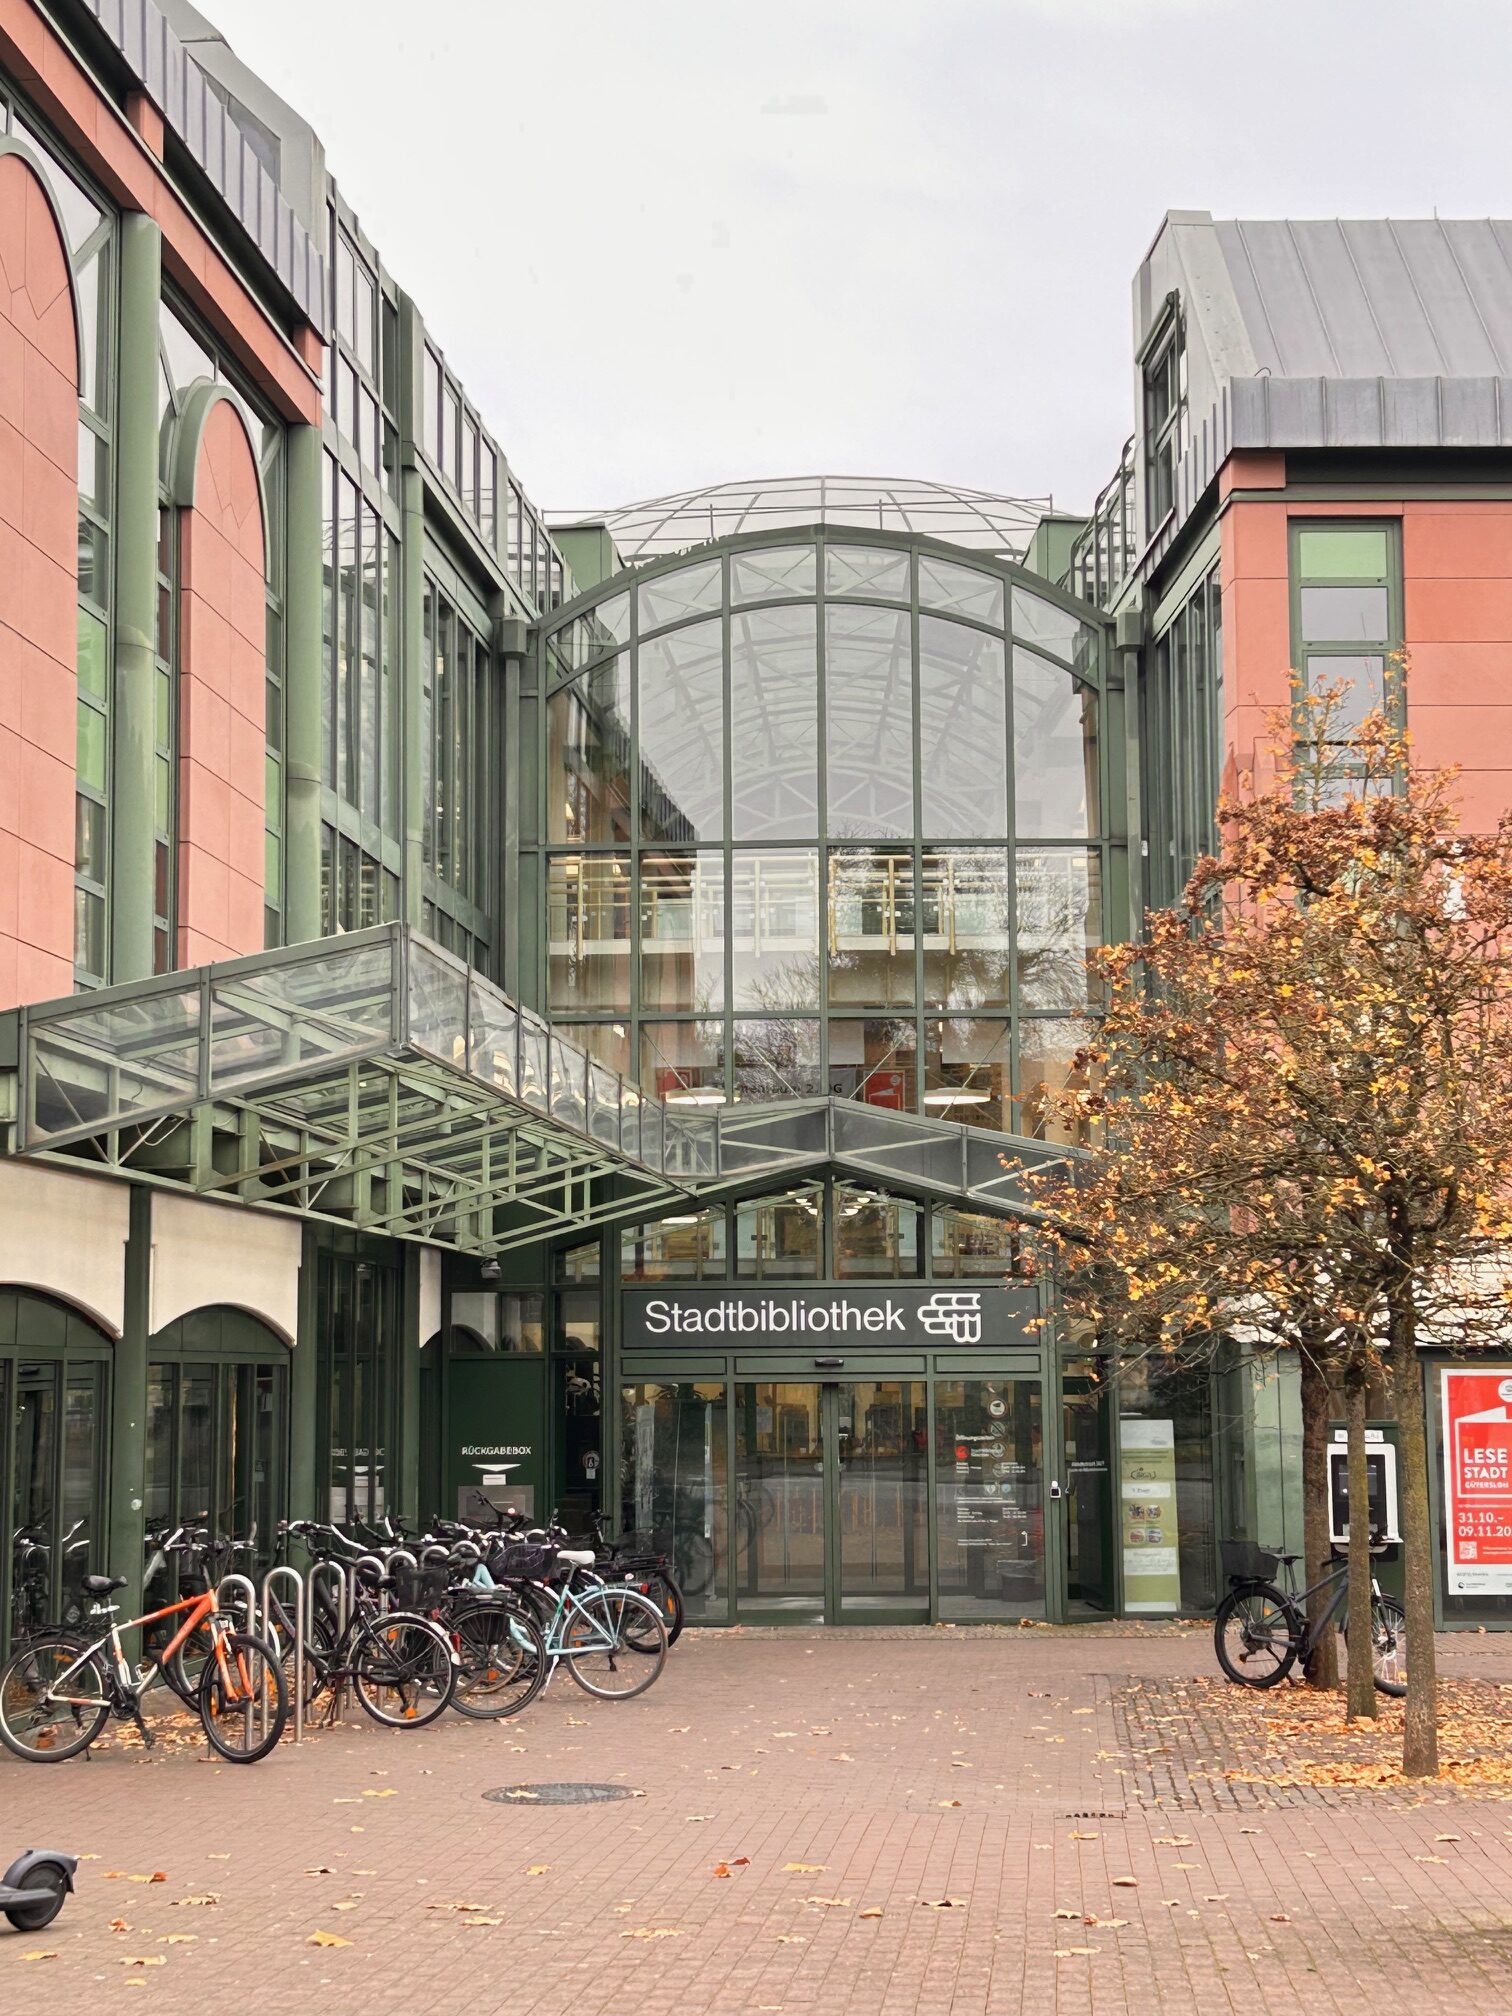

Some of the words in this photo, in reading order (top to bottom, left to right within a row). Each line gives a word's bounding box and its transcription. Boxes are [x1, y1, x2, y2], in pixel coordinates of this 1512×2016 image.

[645, 1300, 906, 1333] Stadtbibliothek
[461, 1445, 532, 1455] RÜCKGABEBOX
[1463, 1448, 1508, 1464] LESE
[1464, 1466, 1508, 1478] STADT
